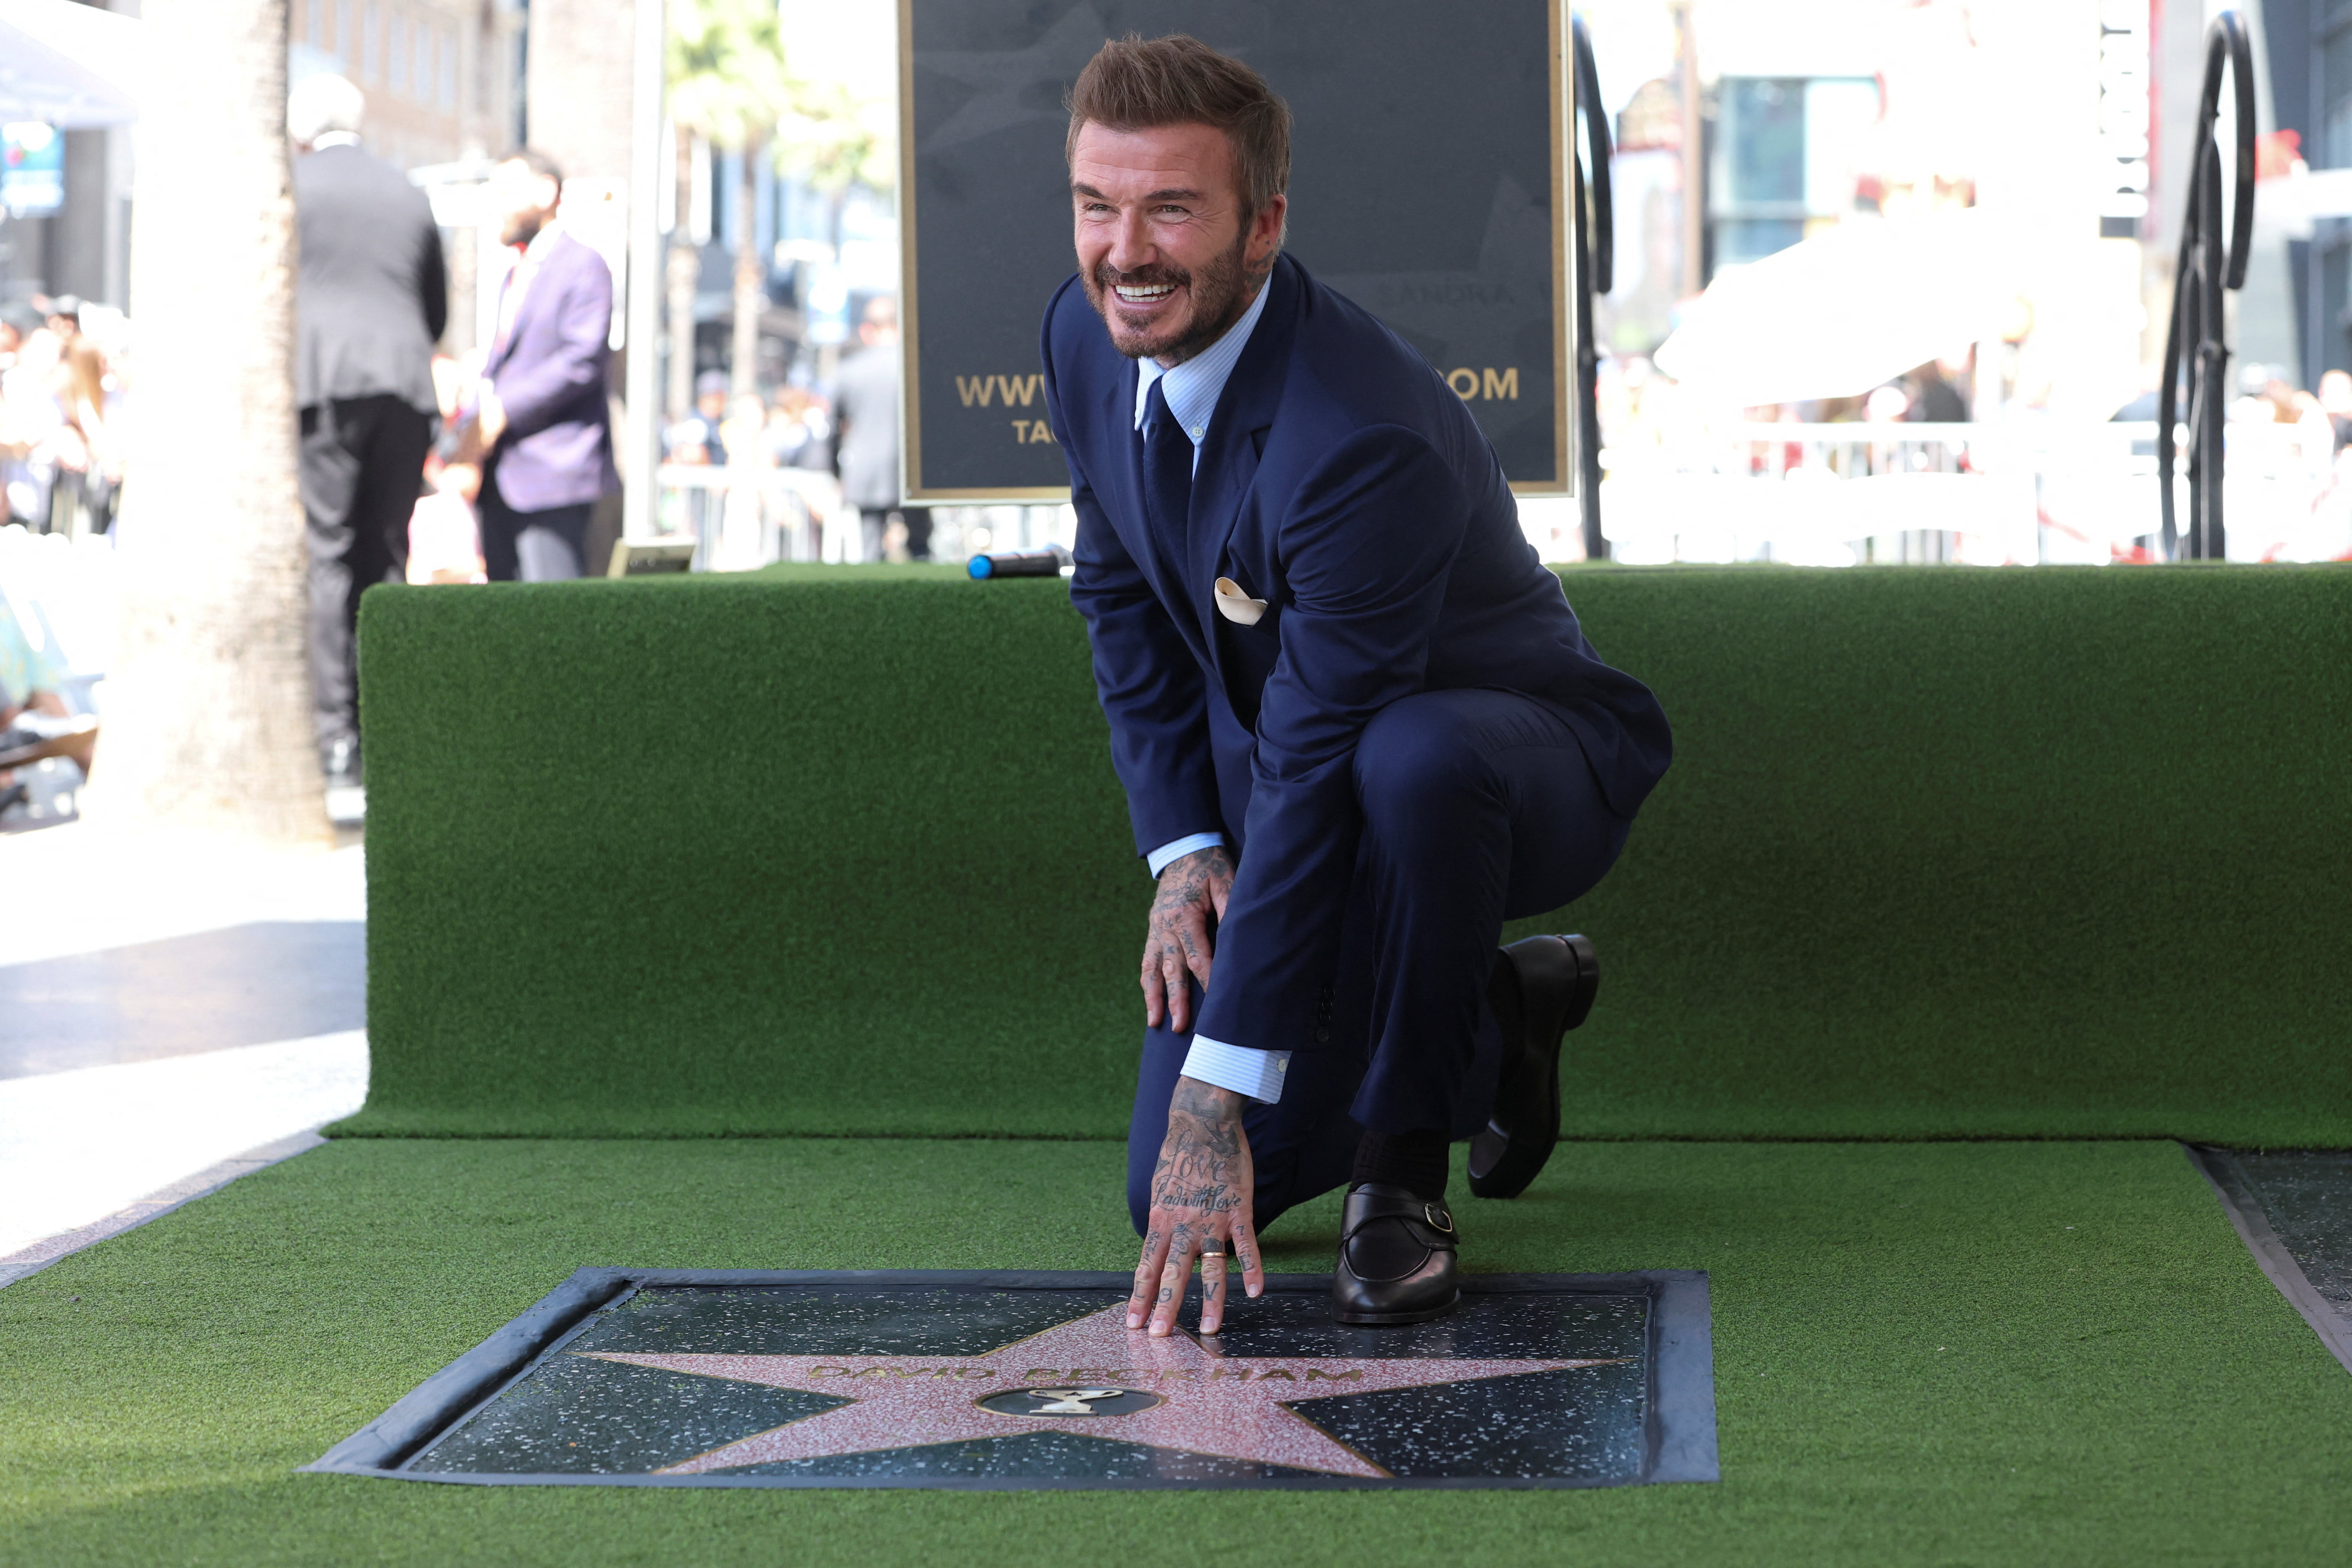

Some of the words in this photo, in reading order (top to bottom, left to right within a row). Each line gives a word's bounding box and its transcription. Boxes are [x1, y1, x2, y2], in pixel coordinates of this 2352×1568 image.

[955, 374, 1047, 407] WW
[1435, 367, 1518, 401] OM
[1011, 420, 1058, 444] TA
[807, 1365, 996, 1380] DAVID
[1024, 1368, 1362, 1381] BECKHAM
